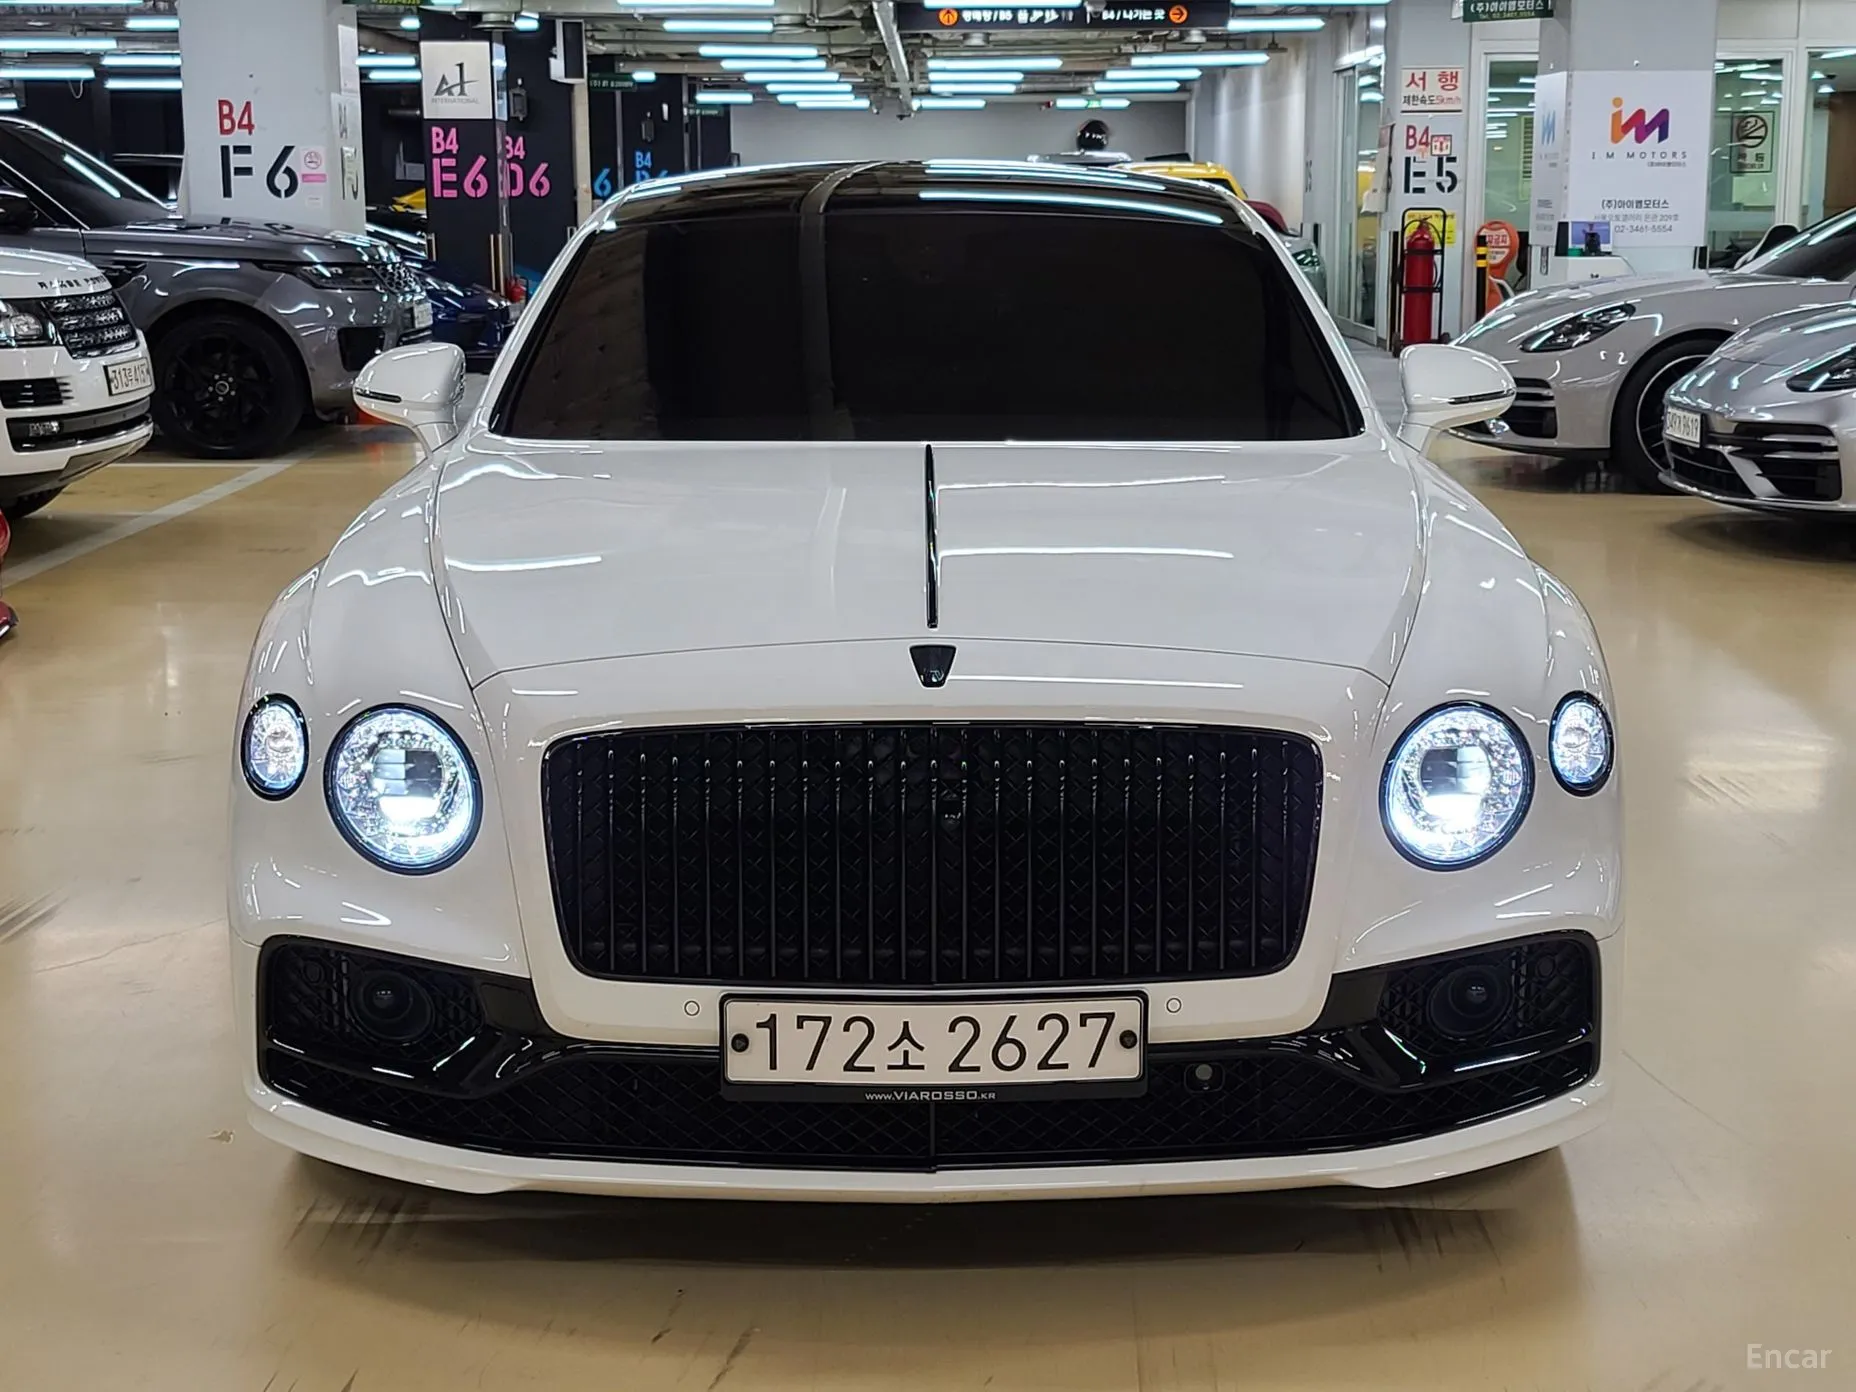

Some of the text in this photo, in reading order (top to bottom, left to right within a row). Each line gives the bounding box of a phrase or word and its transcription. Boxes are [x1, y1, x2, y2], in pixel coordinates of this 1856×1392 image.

[217, 99, 255, 136] B4
[431, 126, 459, 154] B4
[1405, 124, 1430, 150] B4
[635, 151, 652, 168] B4
[1626, 151, 1687, 159] MOTORS
[432, 155, 489, 198] E6
[1614, 224, 1673, 233] 02-3461-5554
[755, 1012, 1116, 1073] 172소 2627
